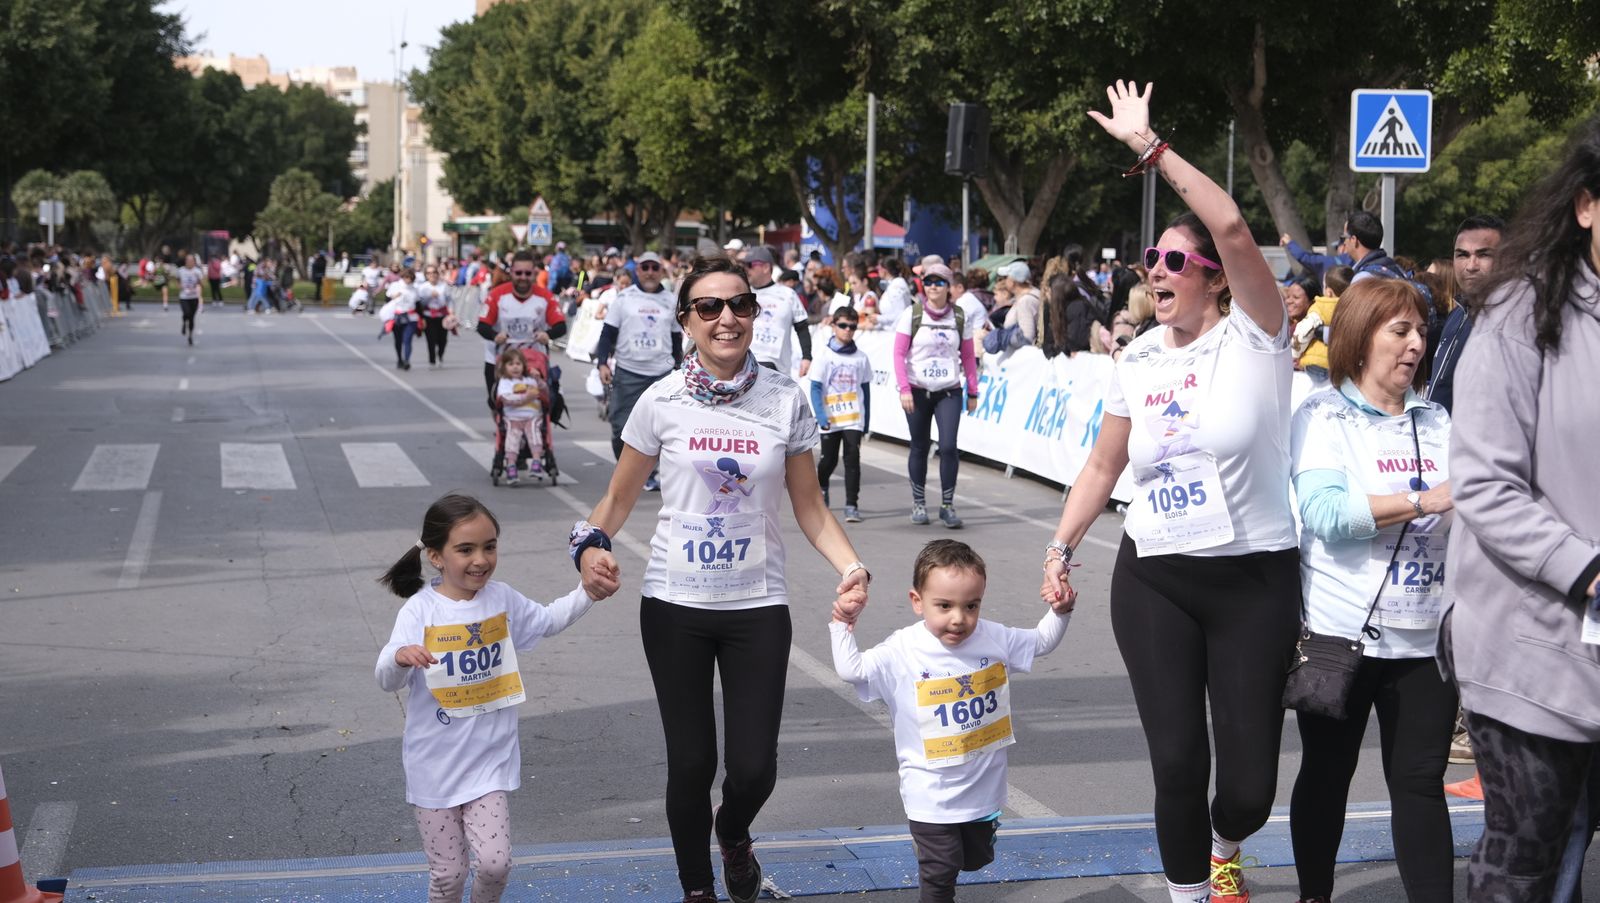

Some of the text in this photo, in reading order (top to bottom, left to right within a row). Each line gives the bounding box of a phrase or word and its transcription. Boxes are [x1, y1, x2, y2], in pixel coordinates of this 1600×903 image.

[634, 339, 657, 348] 1143
[922, 368, 948, 378] 1289
[1145, 373, 1198, 407] MUR
[830, 400, 854, 412] 1811
[693, 427, 755, 438] CARRERA DE LA
[689, 437, 760, 455] MUJER
[1148, 480, 1207, 514] 1095
[1165, 509, 1188, 520] ELOISA
[682, 524, 703, 532] MUJER
[682, 537, 751, 564] 1047
[700, 563, 733, 571] ARACELI
[1386, 560, 1445, 587] 1254
[437, 635, 462, 643] MUJER
[440, 642, 502, 676] 1602
[461, 670, 492, 682] MARTINA
[929, 688, 953, 696] MUJER
[933, 690, 998, 727] 1603
[960, 719, 982, 731] DAVID
